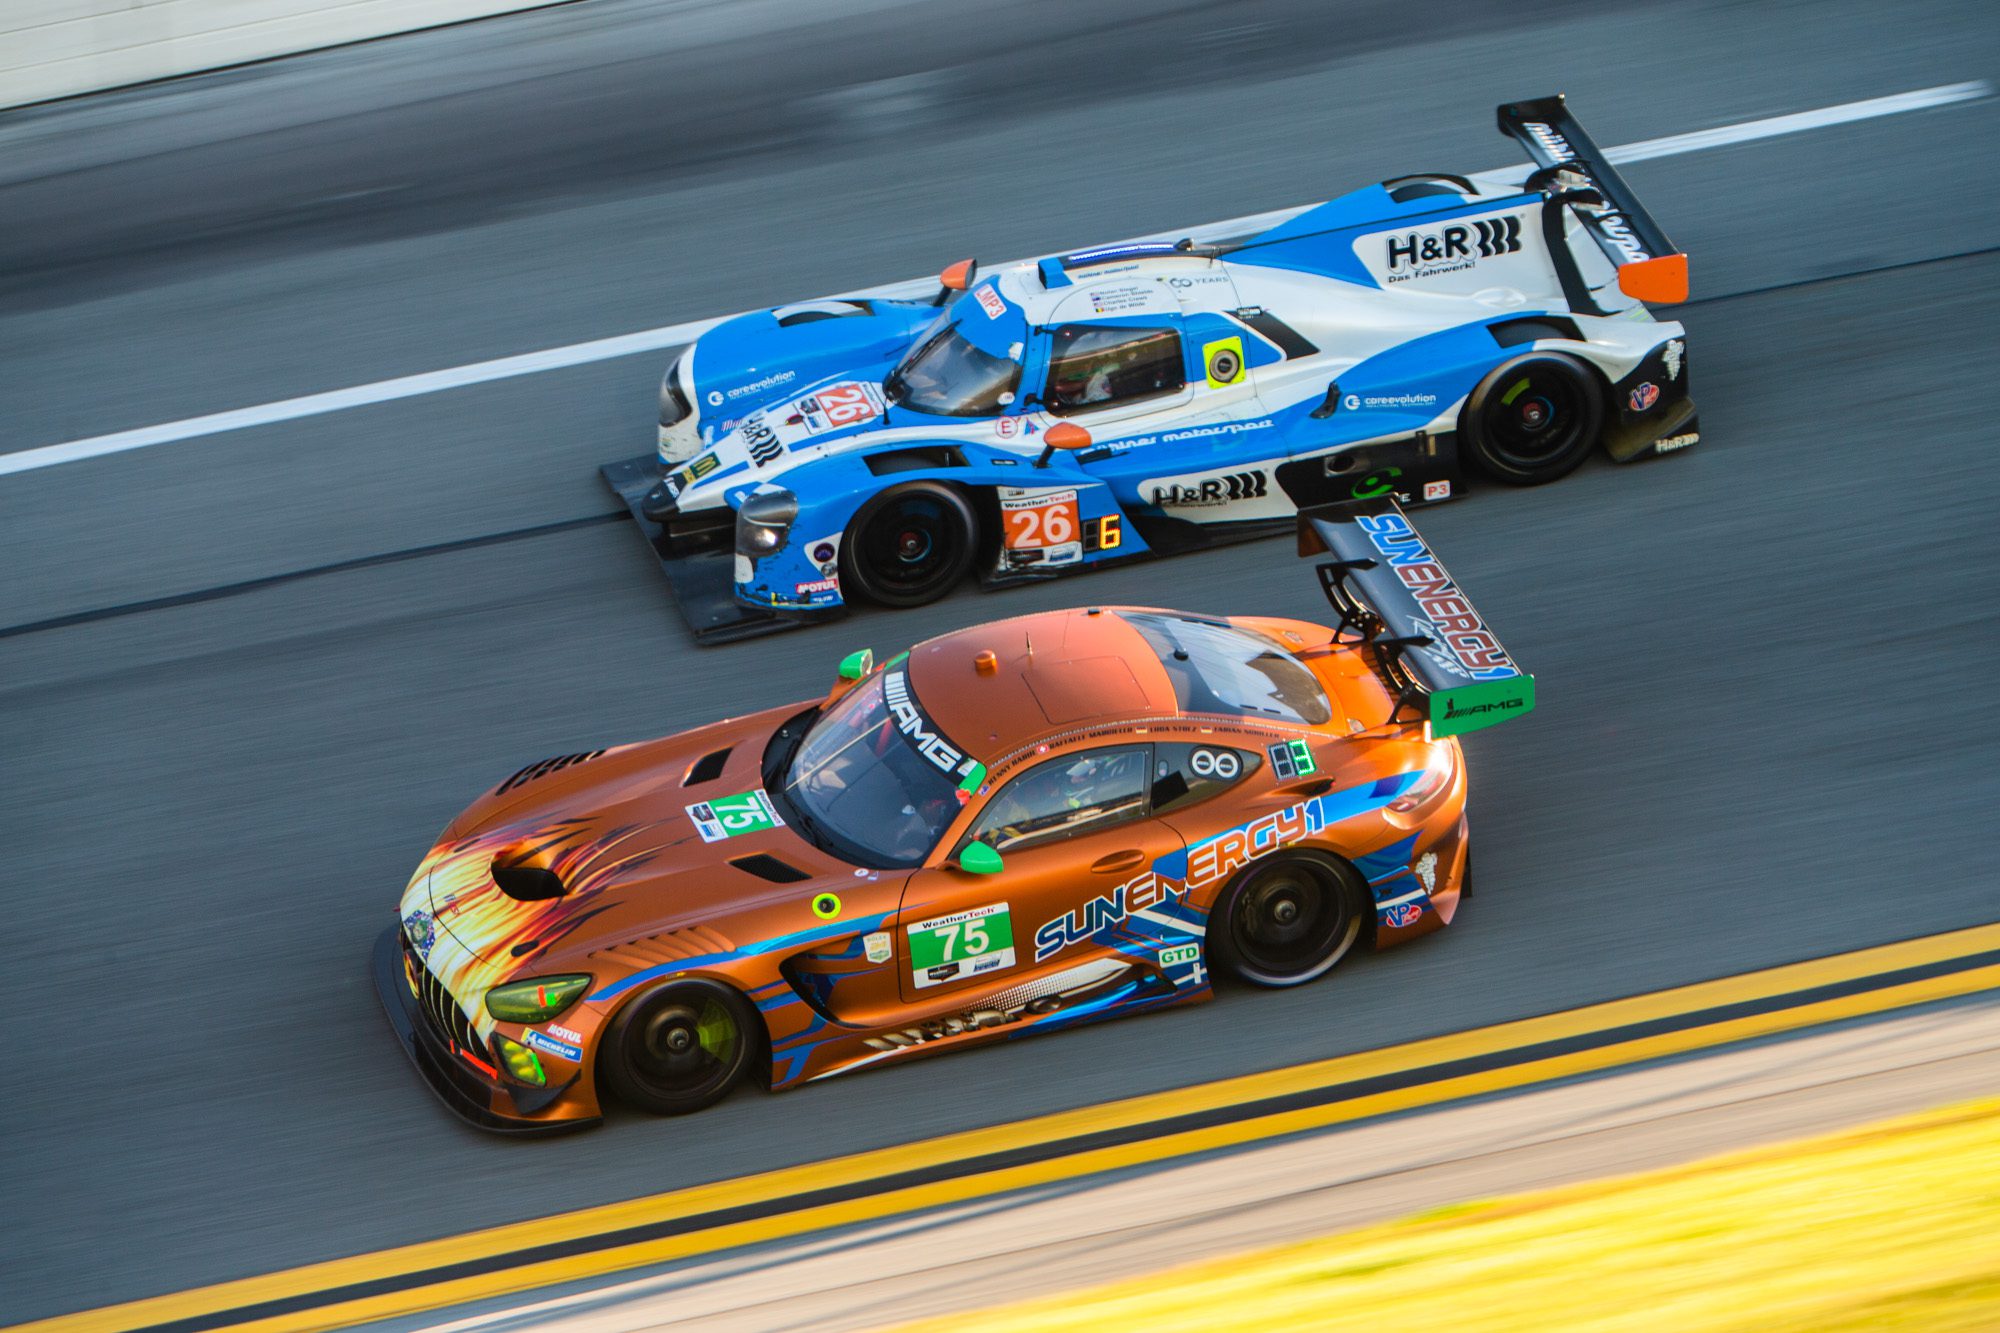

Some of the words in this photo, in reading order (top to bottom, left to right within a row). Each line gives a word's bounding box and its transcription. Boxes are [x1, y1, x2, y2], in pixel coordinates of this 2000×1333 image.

[1195, 275, 1230, 285] YEARS
[1388, 274, 1411, 283] Das
[1415, 261, 1476, 279] Fahrwerk!
[820, 389, 870, 421] 26
[1364, 393, 1436, 405] careevolution
[1163, 419, 1275, 443] motorsport
[1004, 493, 1074, 509] WeatherTech
[1428, 485, 1448, 497] P3
[1012, 504, 1072, 548] 26
[1100, 513, 1120, 550] 6
[797, 580, 835, 594] MOTUL
[1354, 513, 1520, 681] SUNENERGY1
[1470, 698, 1523, 715] AMG
[889, 701, 962, 773] AMG
[715, 796, 768, 829] 75
[1035, 796, 1325, 963] SUNENERGY1
[922, 907, 995, 929] WeatherTech
[935, 918, 989, 962] 75
[1162, 947, 1197, 963] GTD
[547, 1024, 581, 1044] MOTUL
